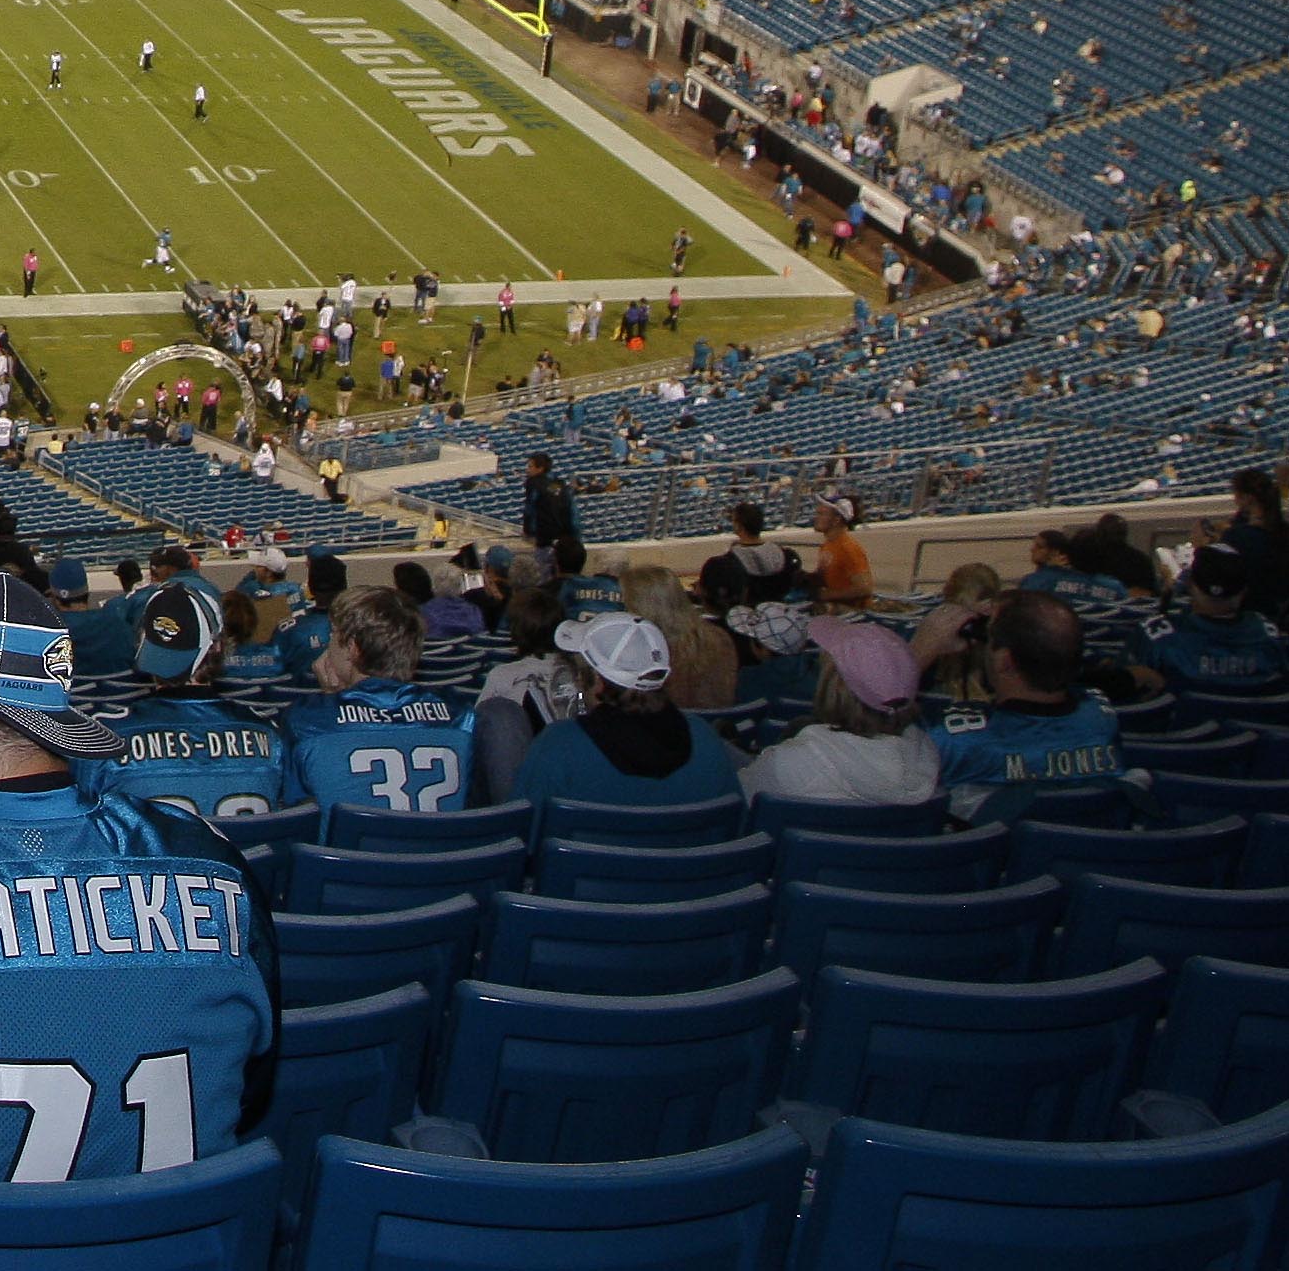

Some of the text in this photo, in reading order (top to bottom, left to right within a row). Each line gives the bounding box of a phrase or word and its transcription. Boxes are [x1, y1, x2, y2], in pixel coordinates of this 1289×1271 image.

[276, 9, 536, 157] JAGUARS
[184, 164, 257, 185] 10
[1, 680, 44, 692] JAGUARS
[337, 701, 451, 724] JONES-DREW
[120, 730, 270, 765] ONES-DREW
[1005, 744, 1118, 781] M. JONES
[349, 746, 460, 812] 32
